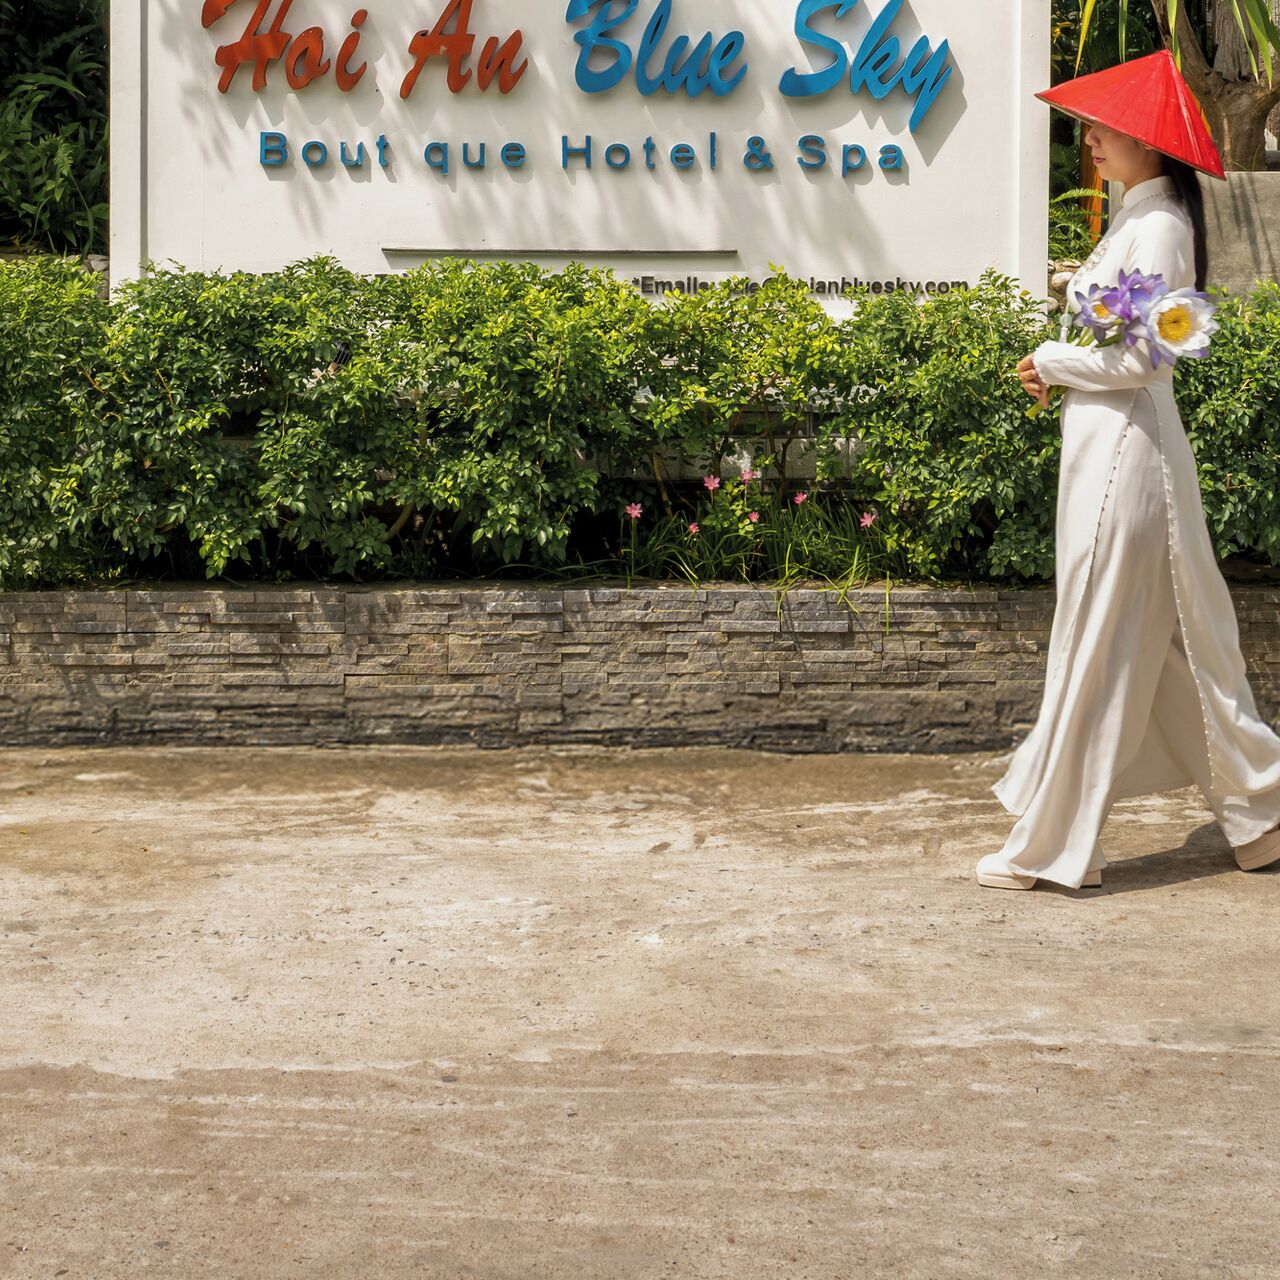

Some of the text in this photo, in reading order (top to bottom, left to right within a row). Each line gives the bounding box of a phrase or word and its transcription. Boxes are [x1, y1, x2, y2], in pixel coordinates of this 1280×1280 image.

[562, 132, 717, 169] Hotel
[743, 135, 774, 170] &
[797, 135, 904, 176] Spa
